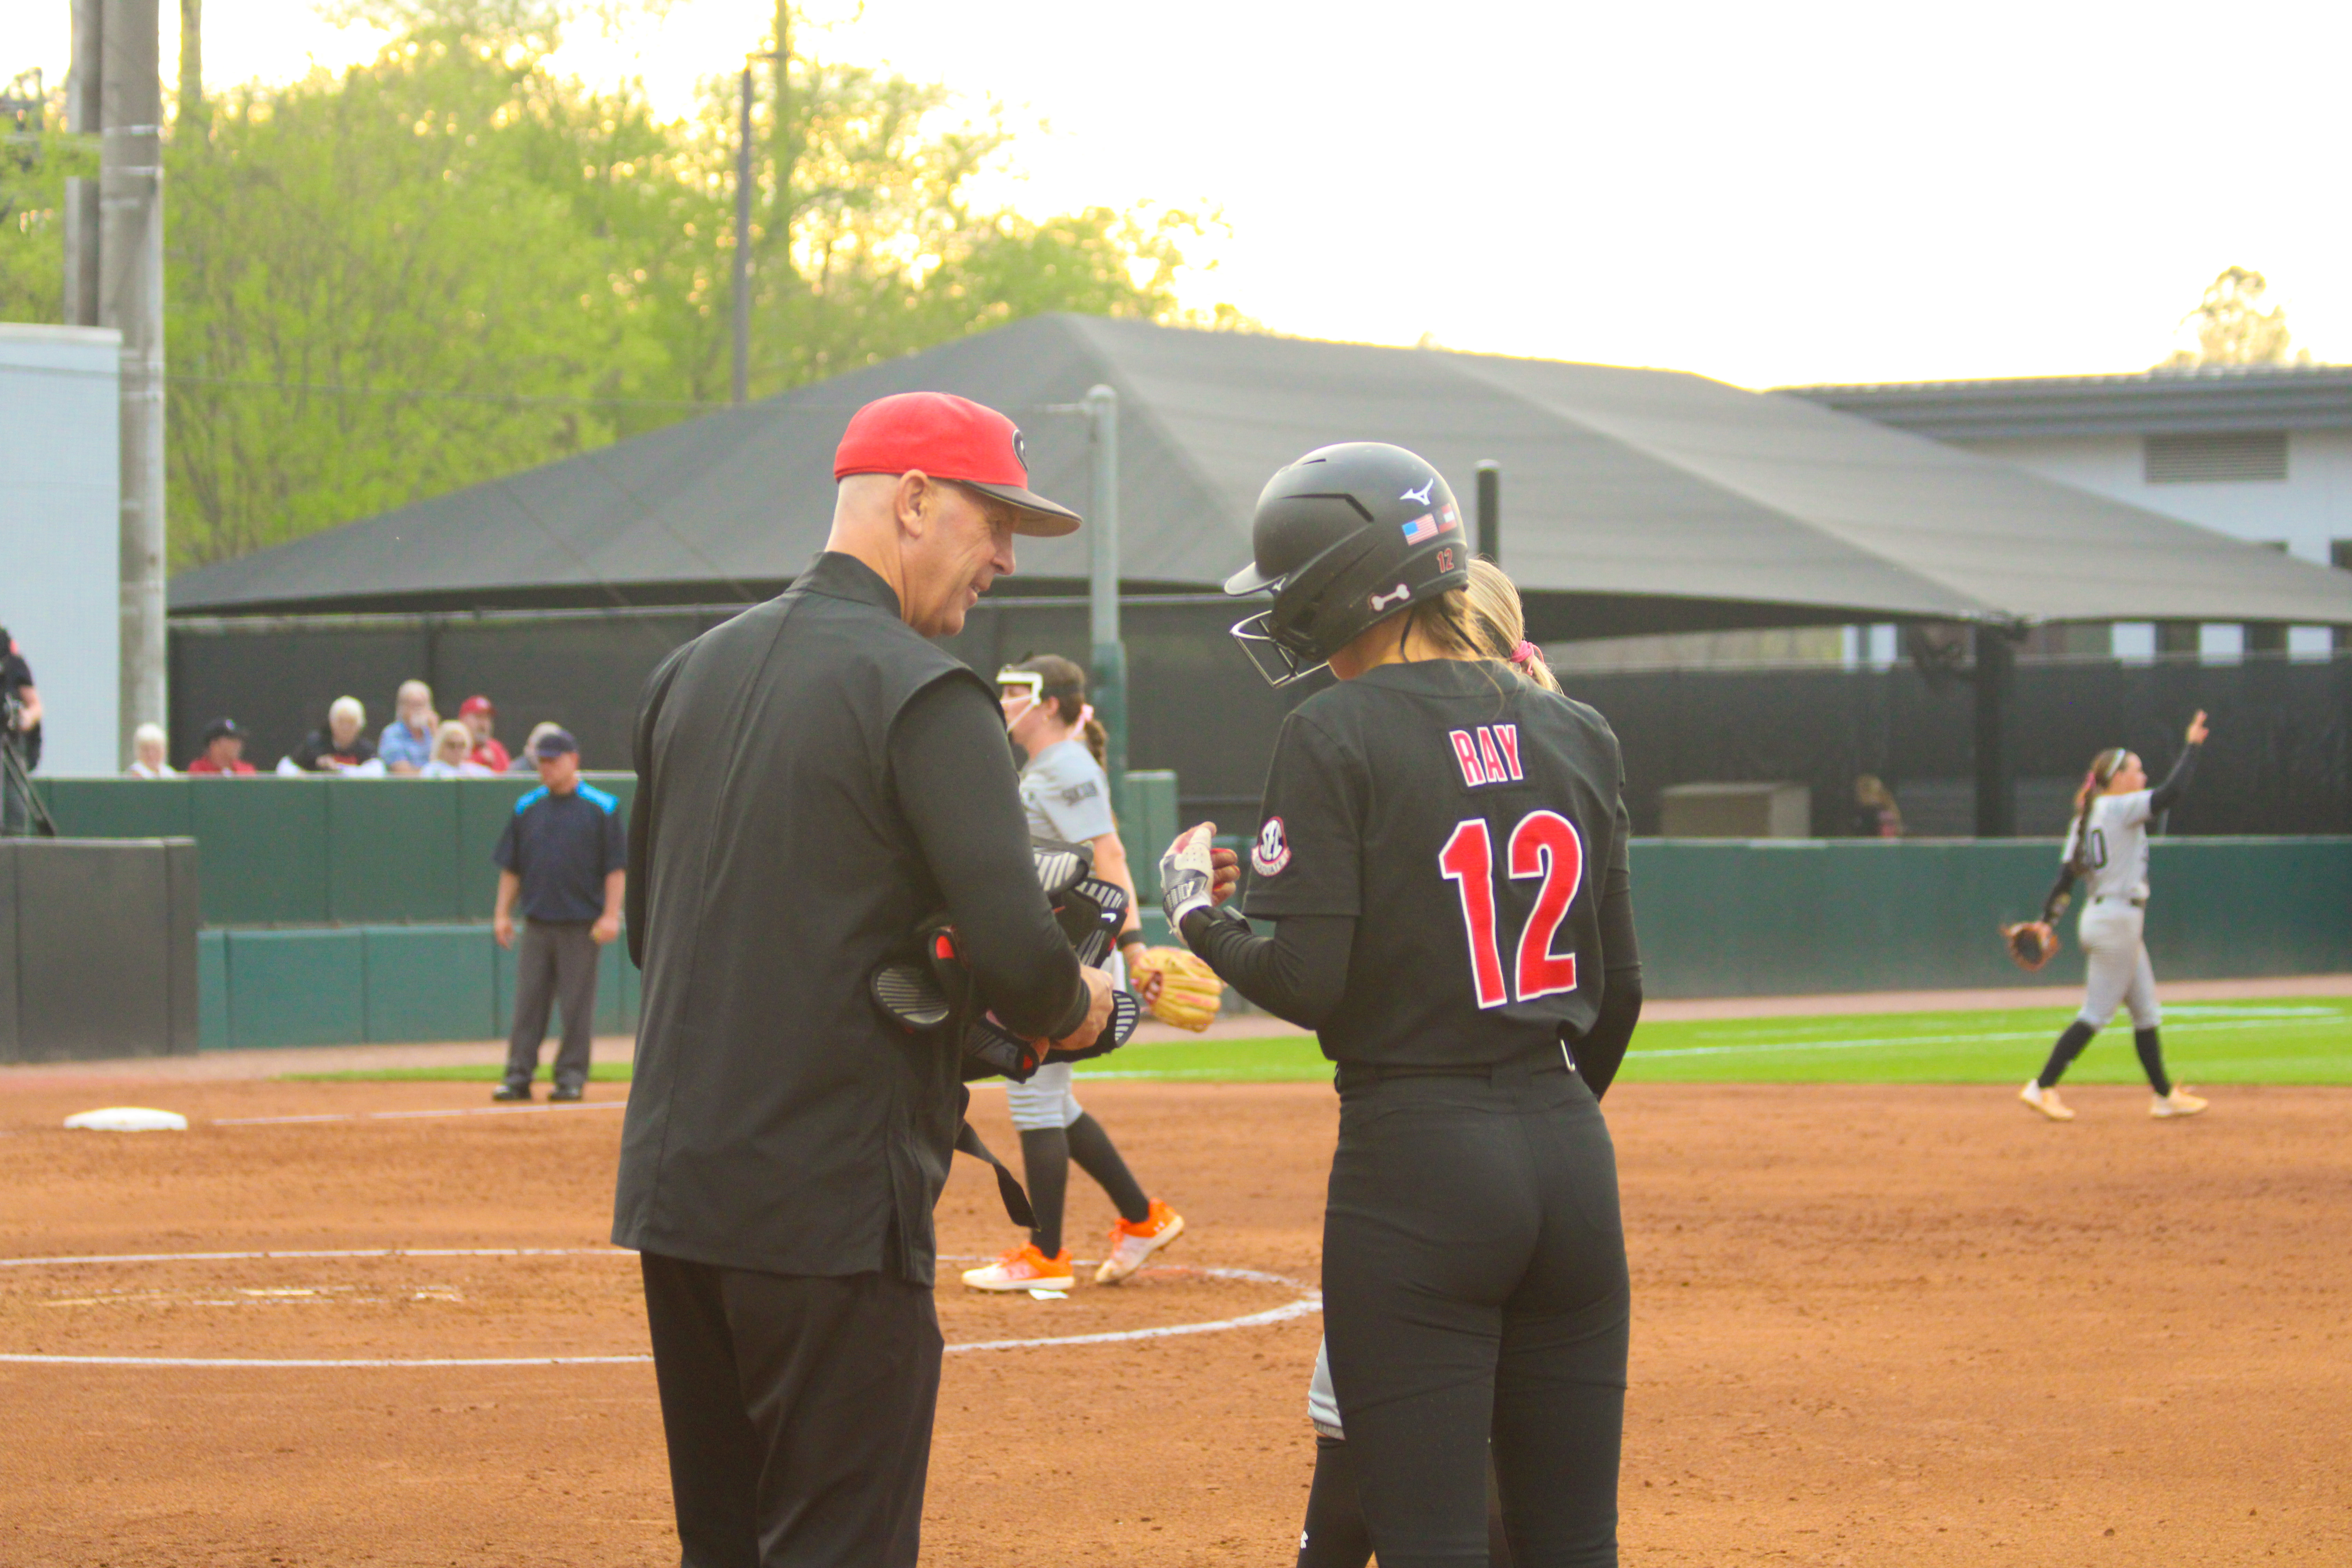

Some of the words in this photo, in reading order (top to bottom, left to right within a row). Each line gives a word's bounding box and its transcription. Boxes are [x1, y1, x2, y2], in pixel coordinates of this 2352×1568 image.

[1436, 548, 1455, 573] 12
[1449, 724, 1523, 787] RAY
[1260, 819, 1283, 861] SEC
[1439, 810, 1582, 1009] 12
